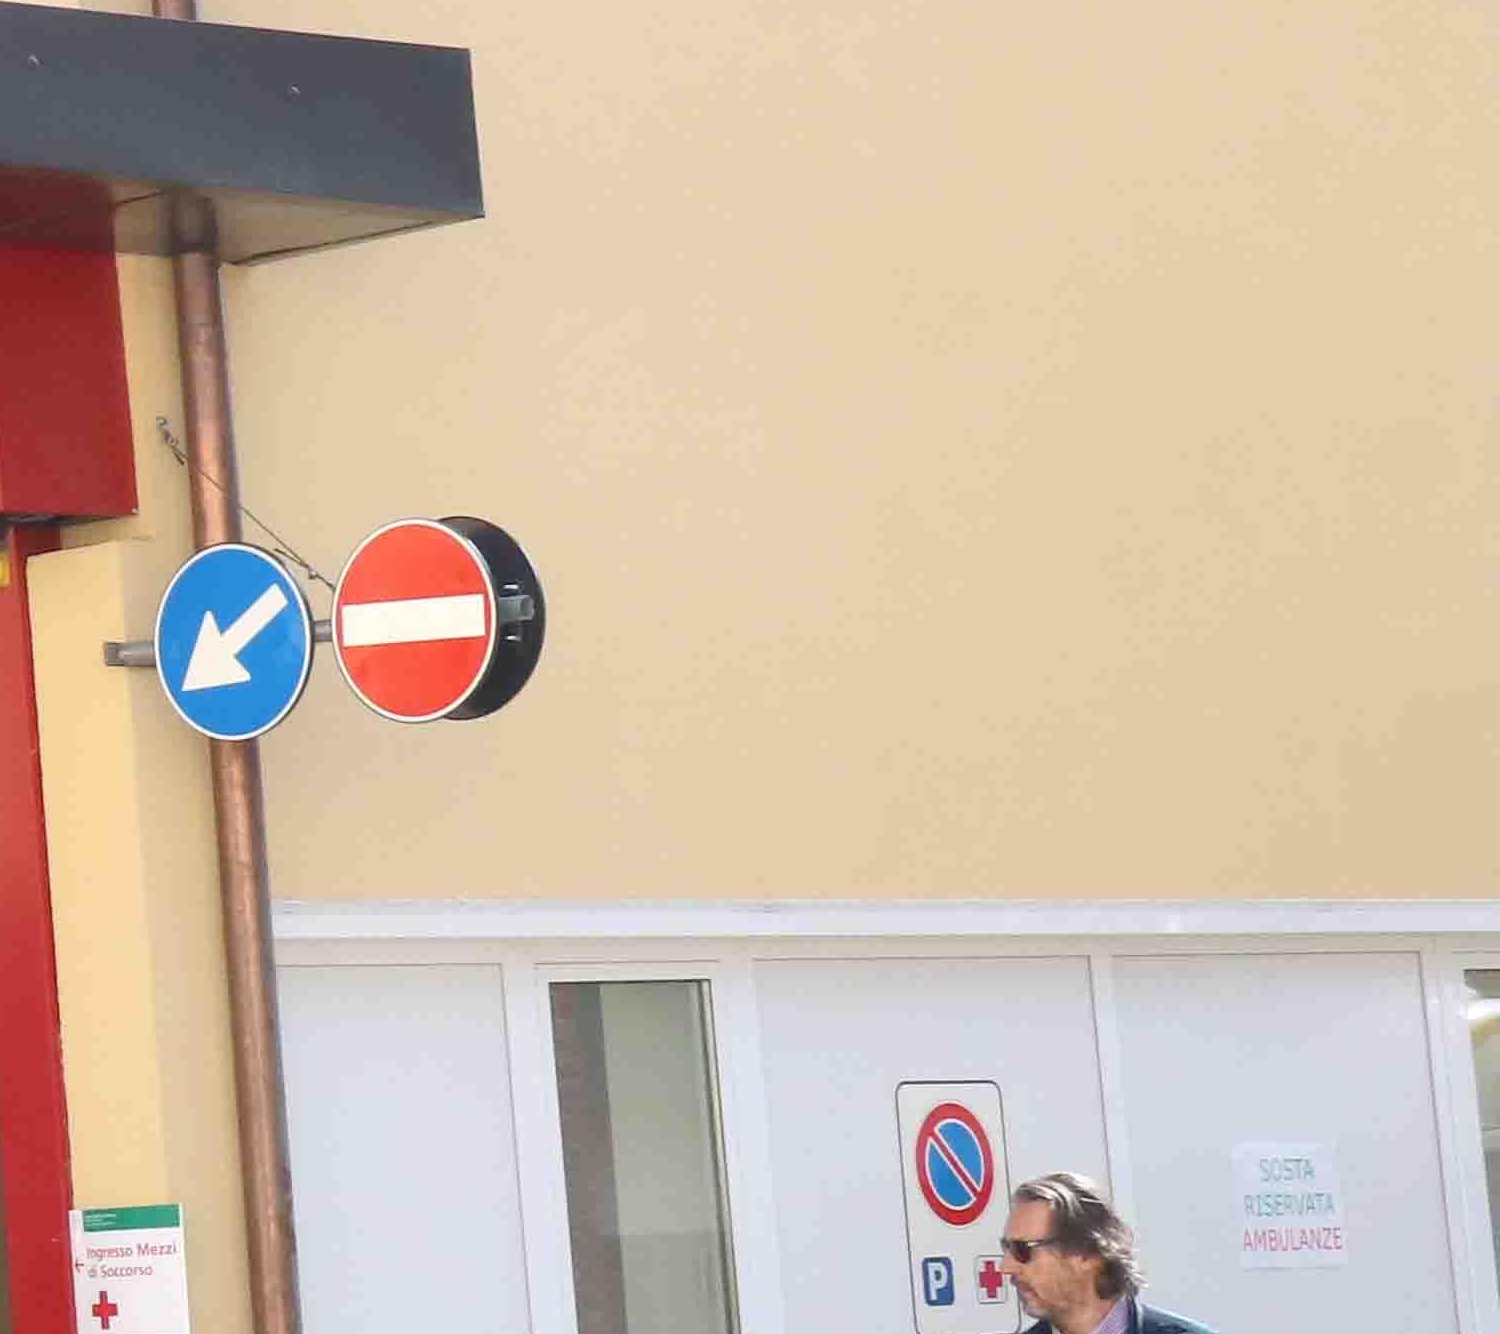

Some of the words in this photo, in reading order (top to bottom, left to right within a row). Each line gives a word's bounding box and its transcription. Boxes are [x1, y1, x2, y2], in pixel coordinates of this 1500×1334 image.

[1259, 1157, 1316, 1182] SOSTA
[1243, 1192, 1336, 1217] RISERVATA
[87, 1245, 133, 1262] Ingresso
[136, 1240, 177, 1256] Mezzi
[1243, 1226, 1343, 1251] AMBULANZE
[100, 1264, 153, 1279] Soccorso
[927, 1261, 949, 1301] P
